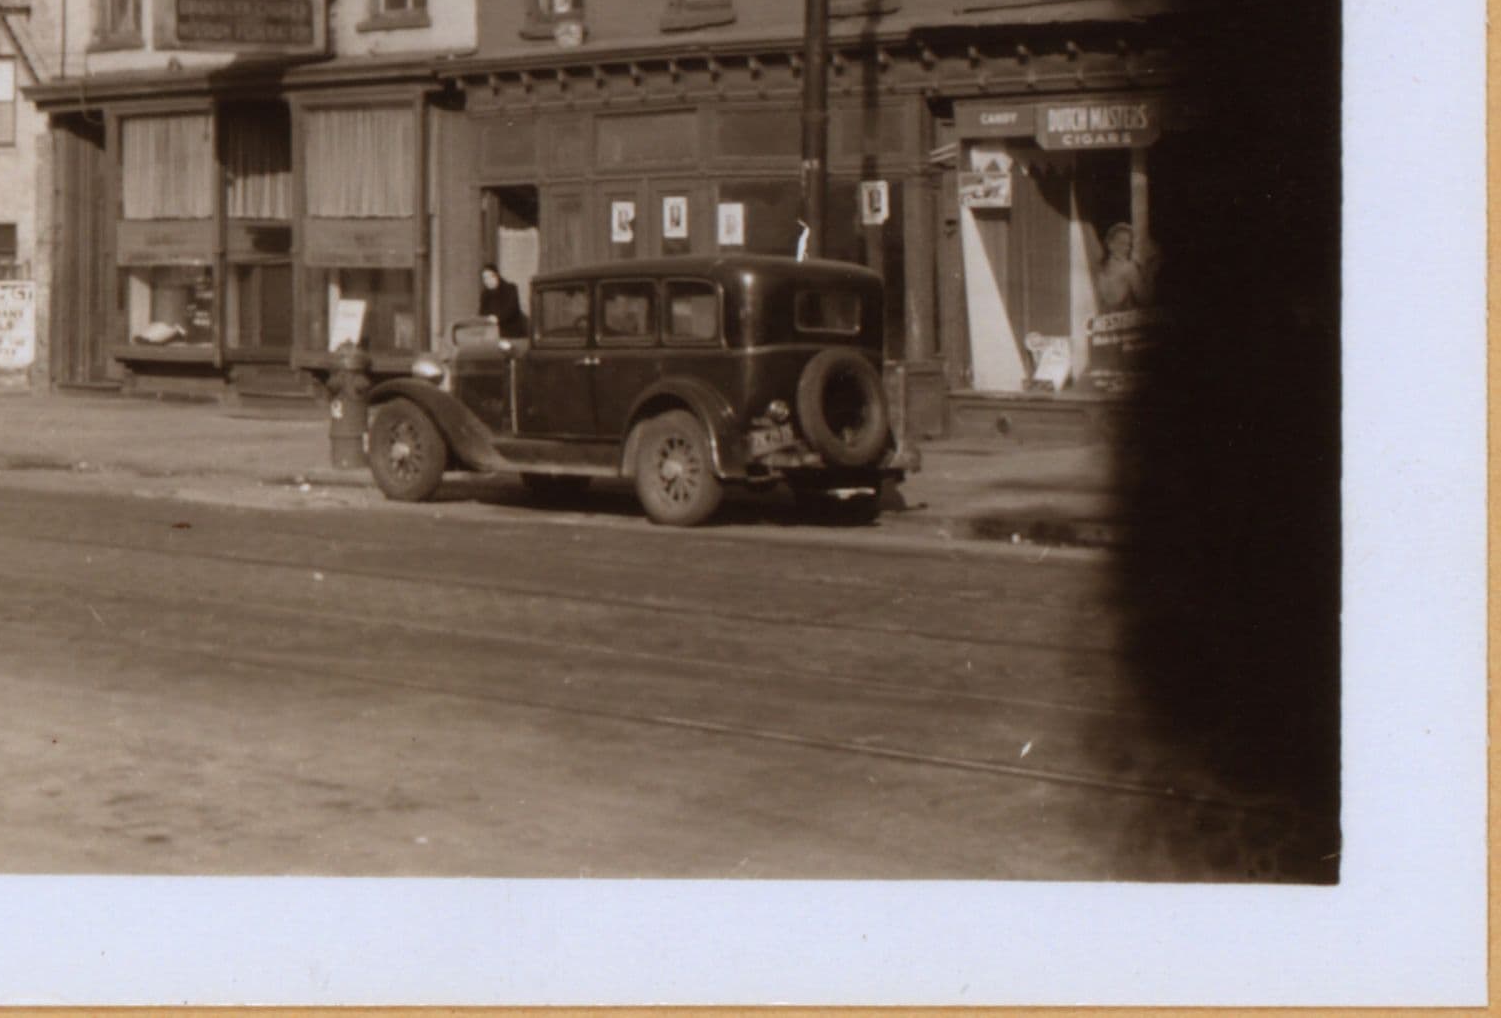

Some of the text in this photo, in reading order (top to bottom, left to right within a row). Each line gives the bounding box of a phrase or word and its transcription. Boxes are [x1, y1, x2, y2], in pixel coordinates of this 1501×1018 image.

[979, 111, 1018, 126] CANDY
[1047, 104, 1149, 132] DUTCH MASTERS
[1061, 132, 1132, 146] CIGARS
